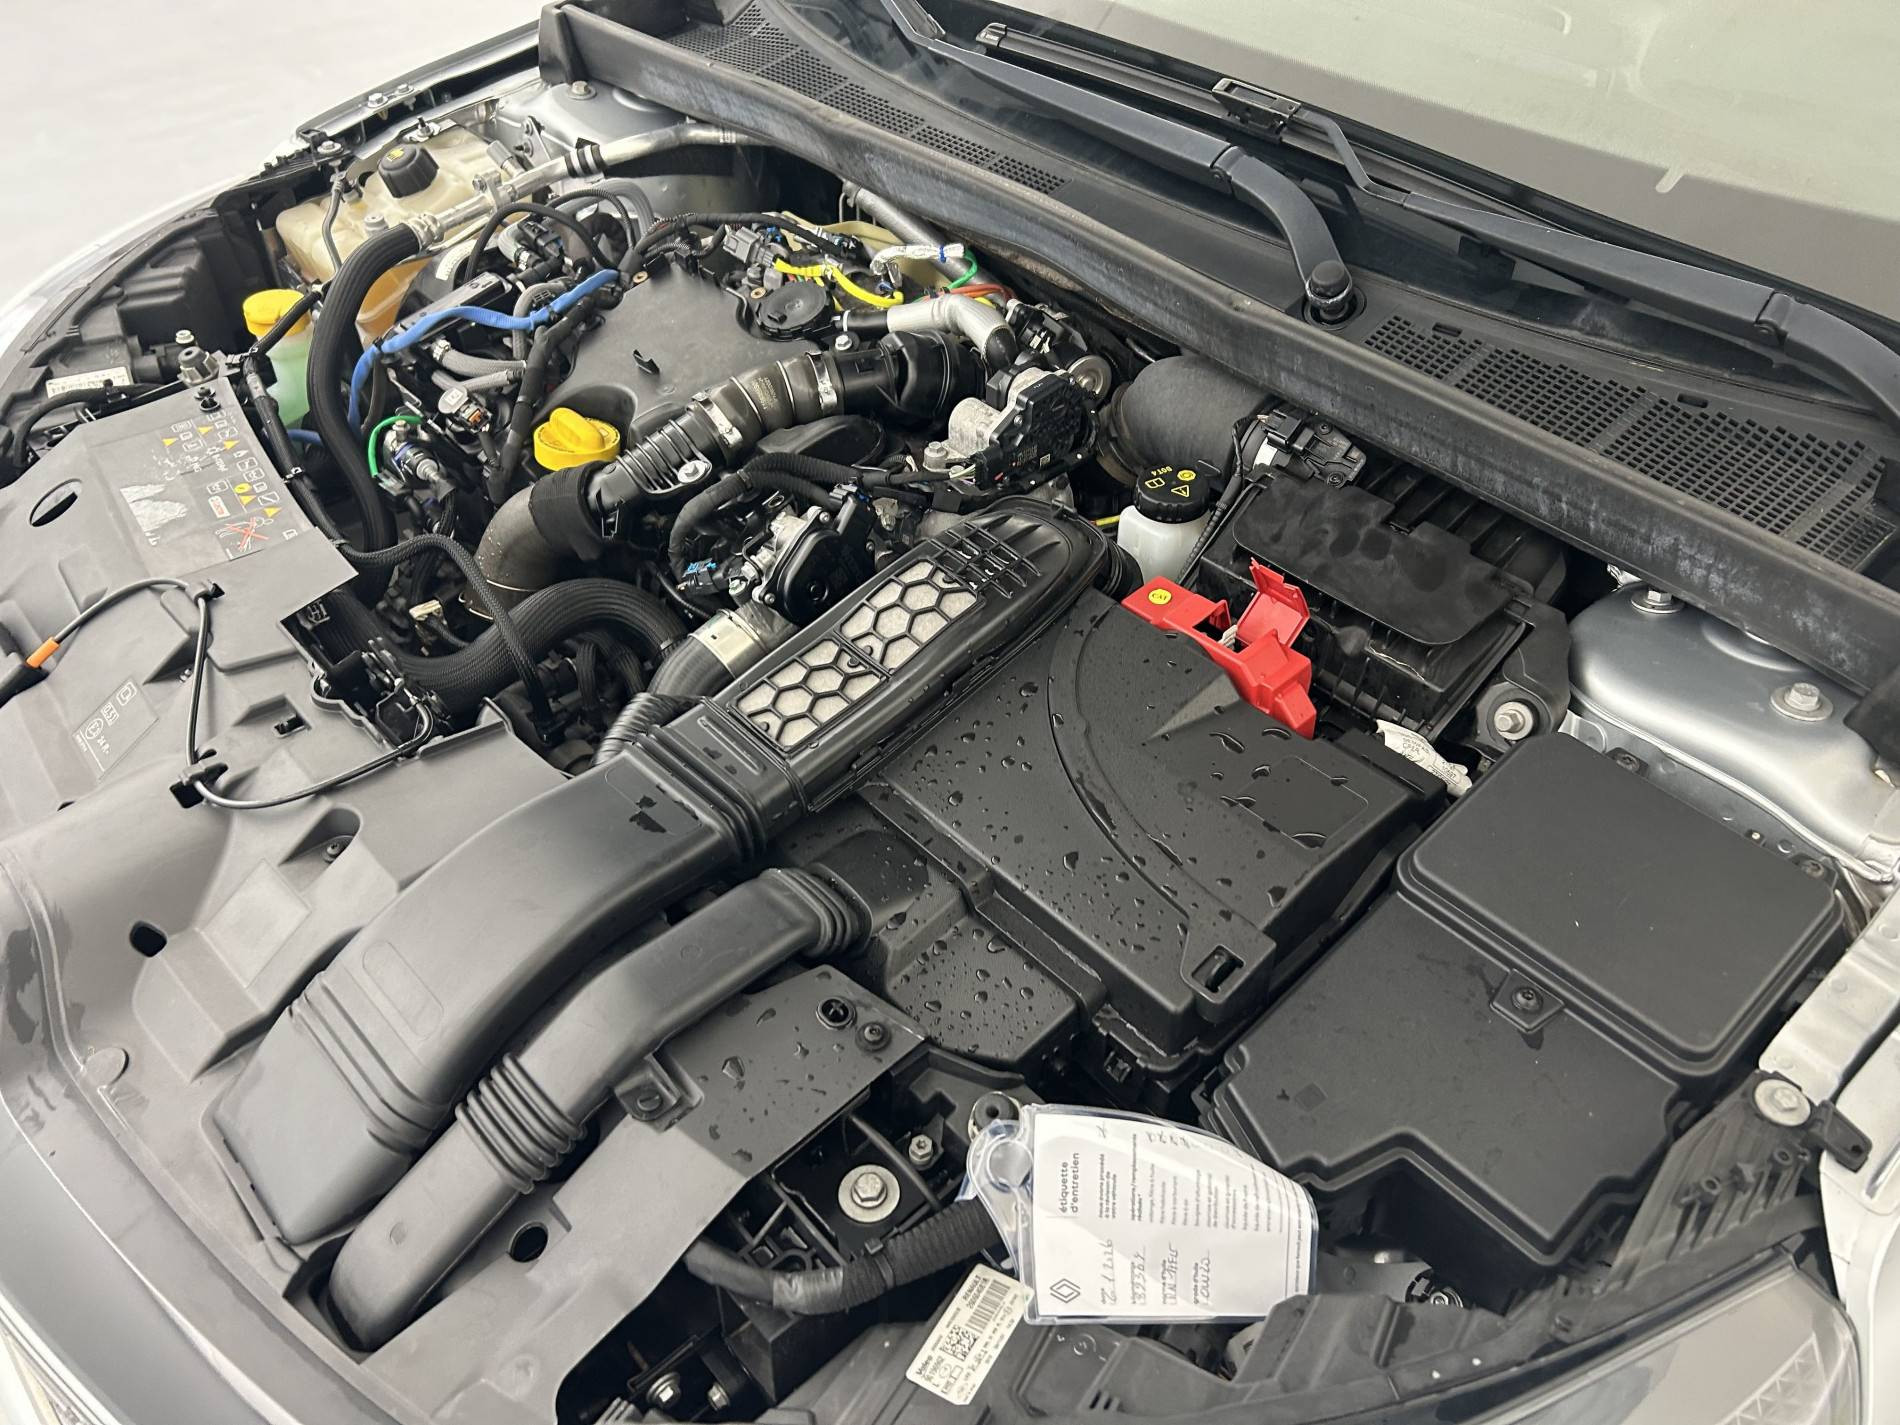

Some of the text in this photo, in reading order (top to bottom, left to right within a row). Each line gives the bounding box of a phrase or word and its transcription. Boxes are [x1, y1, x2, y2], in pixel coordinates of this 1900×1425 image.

[1157, 466, 1173, 475] DOT
[1071, 1152, 1079, 1213] d'entretien
[1106, 1171, 1111, 1179] de
[1058, 1161, 1069, 1213] étiquette
[916, 1355, 933, 1375] Valeo
